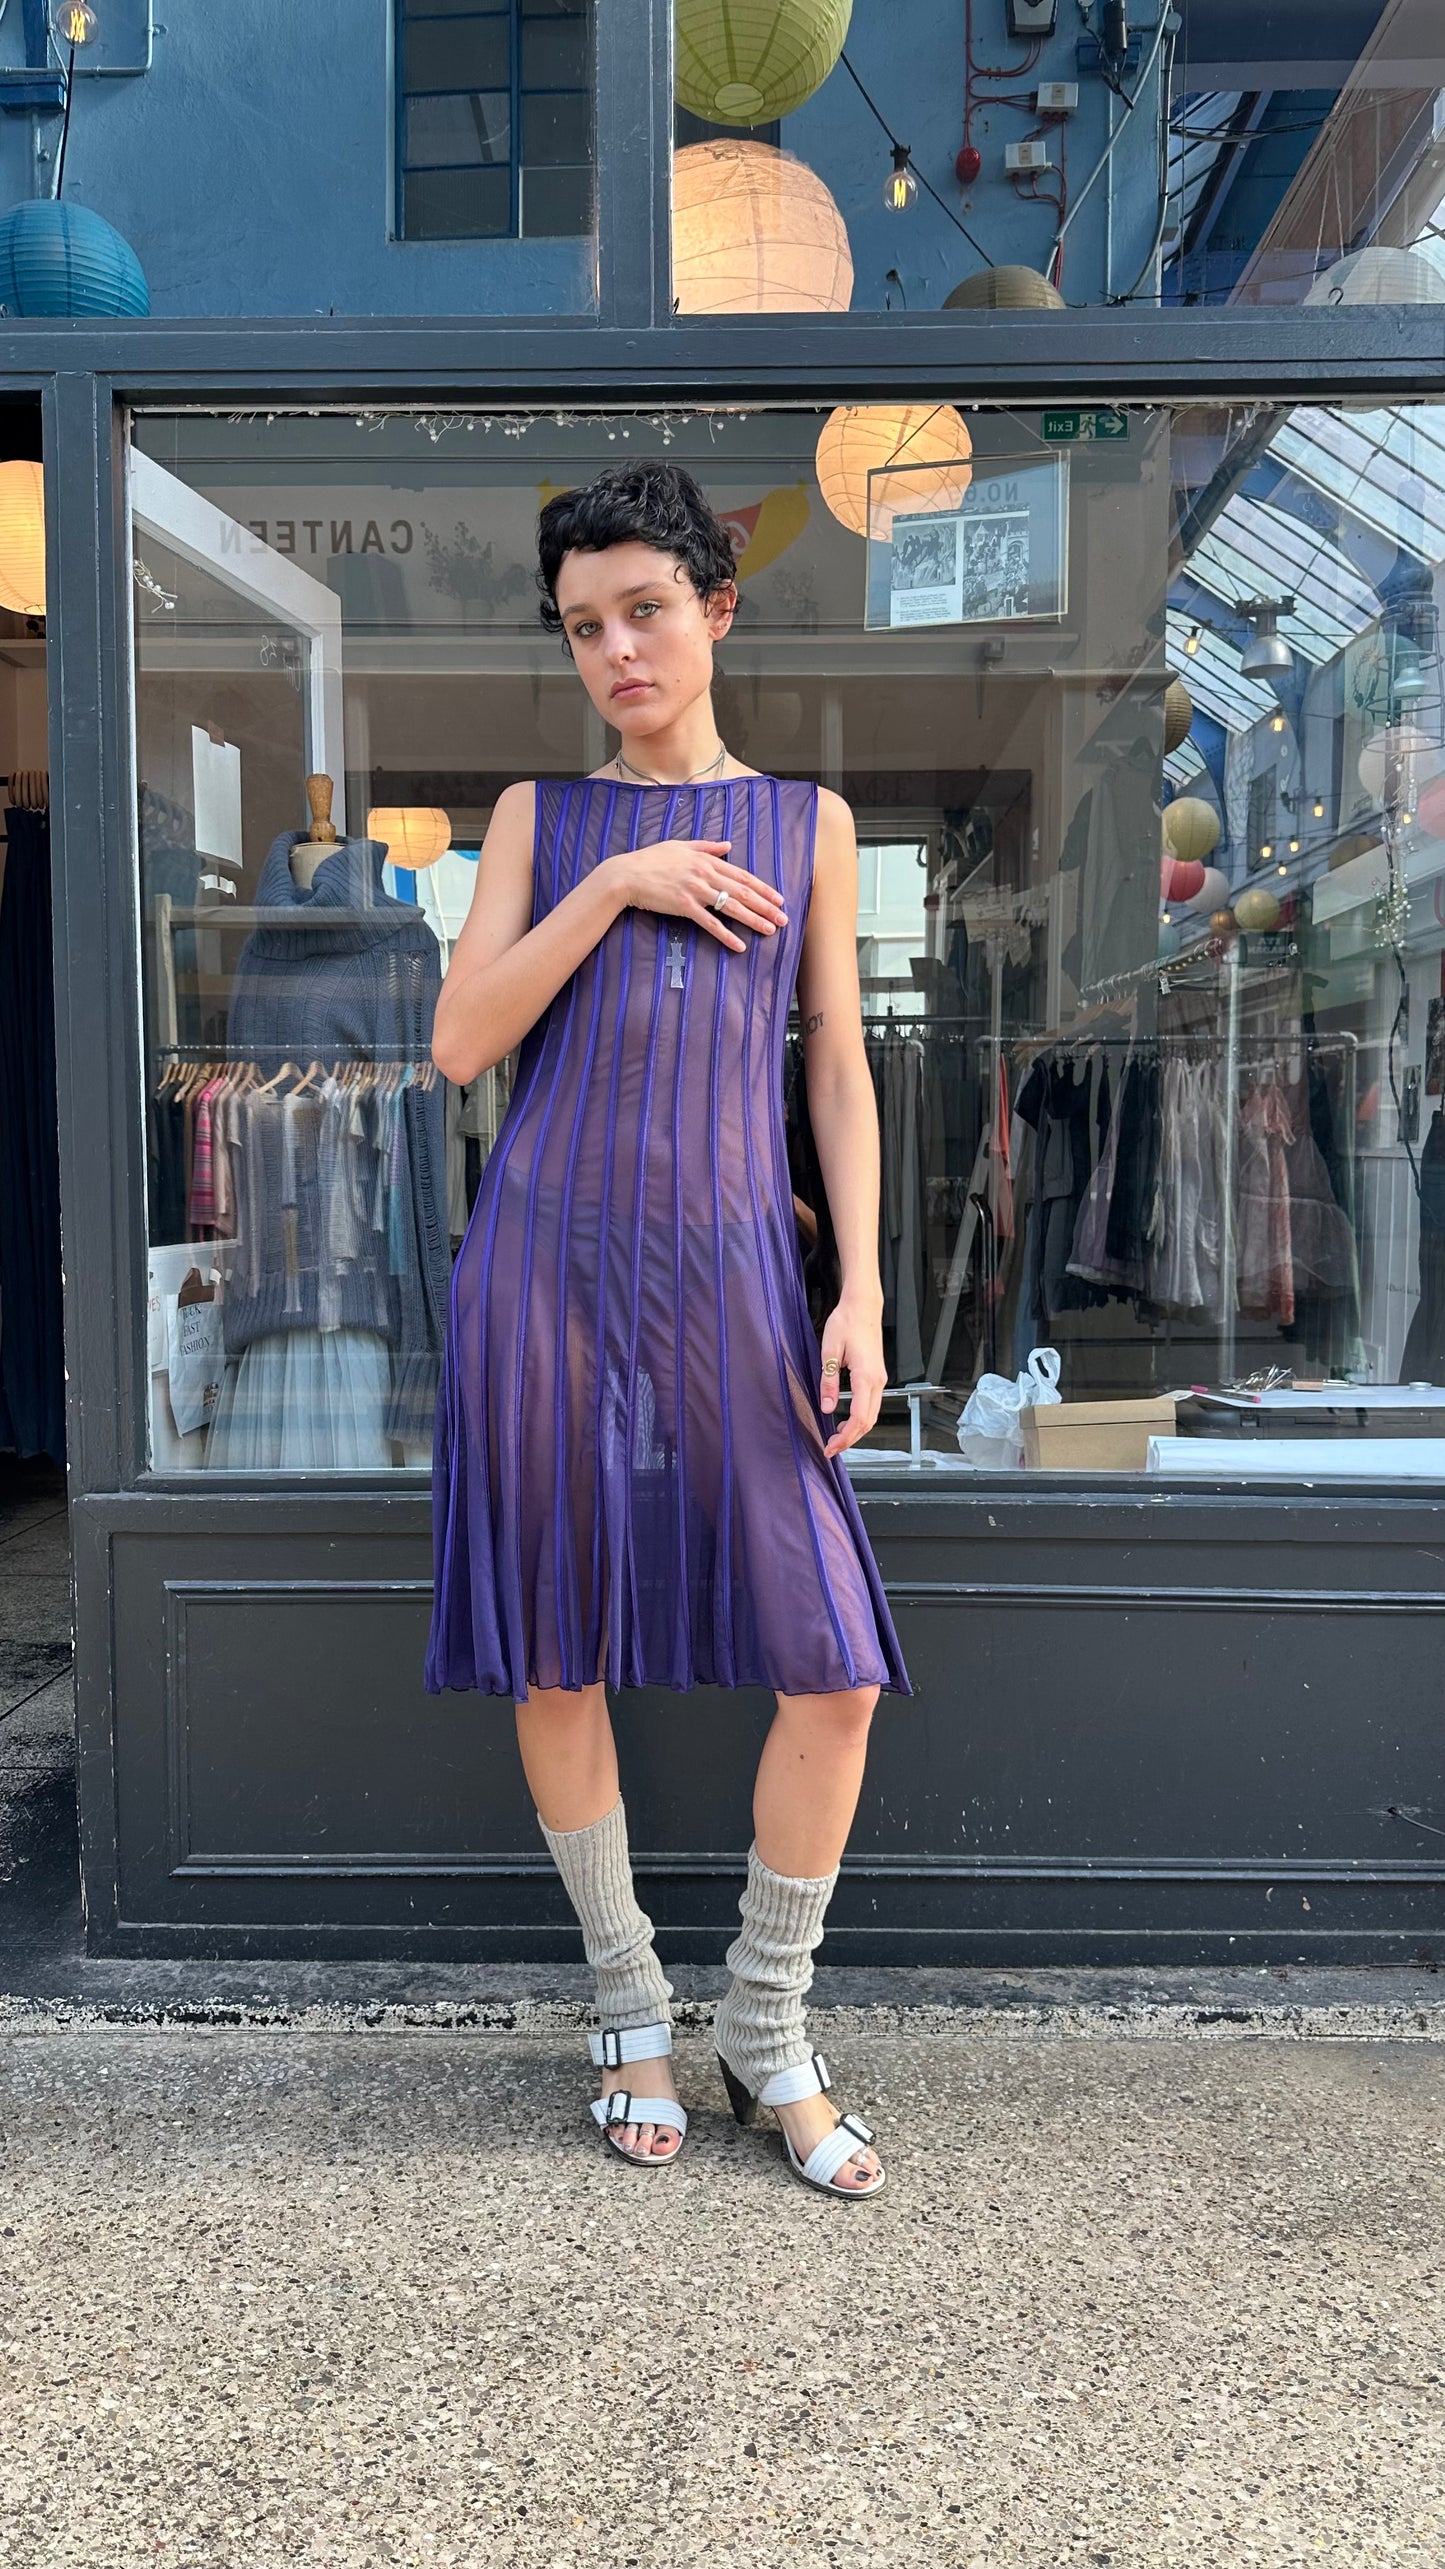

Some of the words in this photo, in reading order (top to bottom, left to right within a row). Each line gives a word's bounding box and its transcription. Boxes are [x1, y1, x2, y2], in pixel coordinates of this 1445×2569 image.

[845, 776, 913, 802] AGE
[183, 1322, 201, 1337] FAST
[179, 1335, 211, 1357] FASHION
